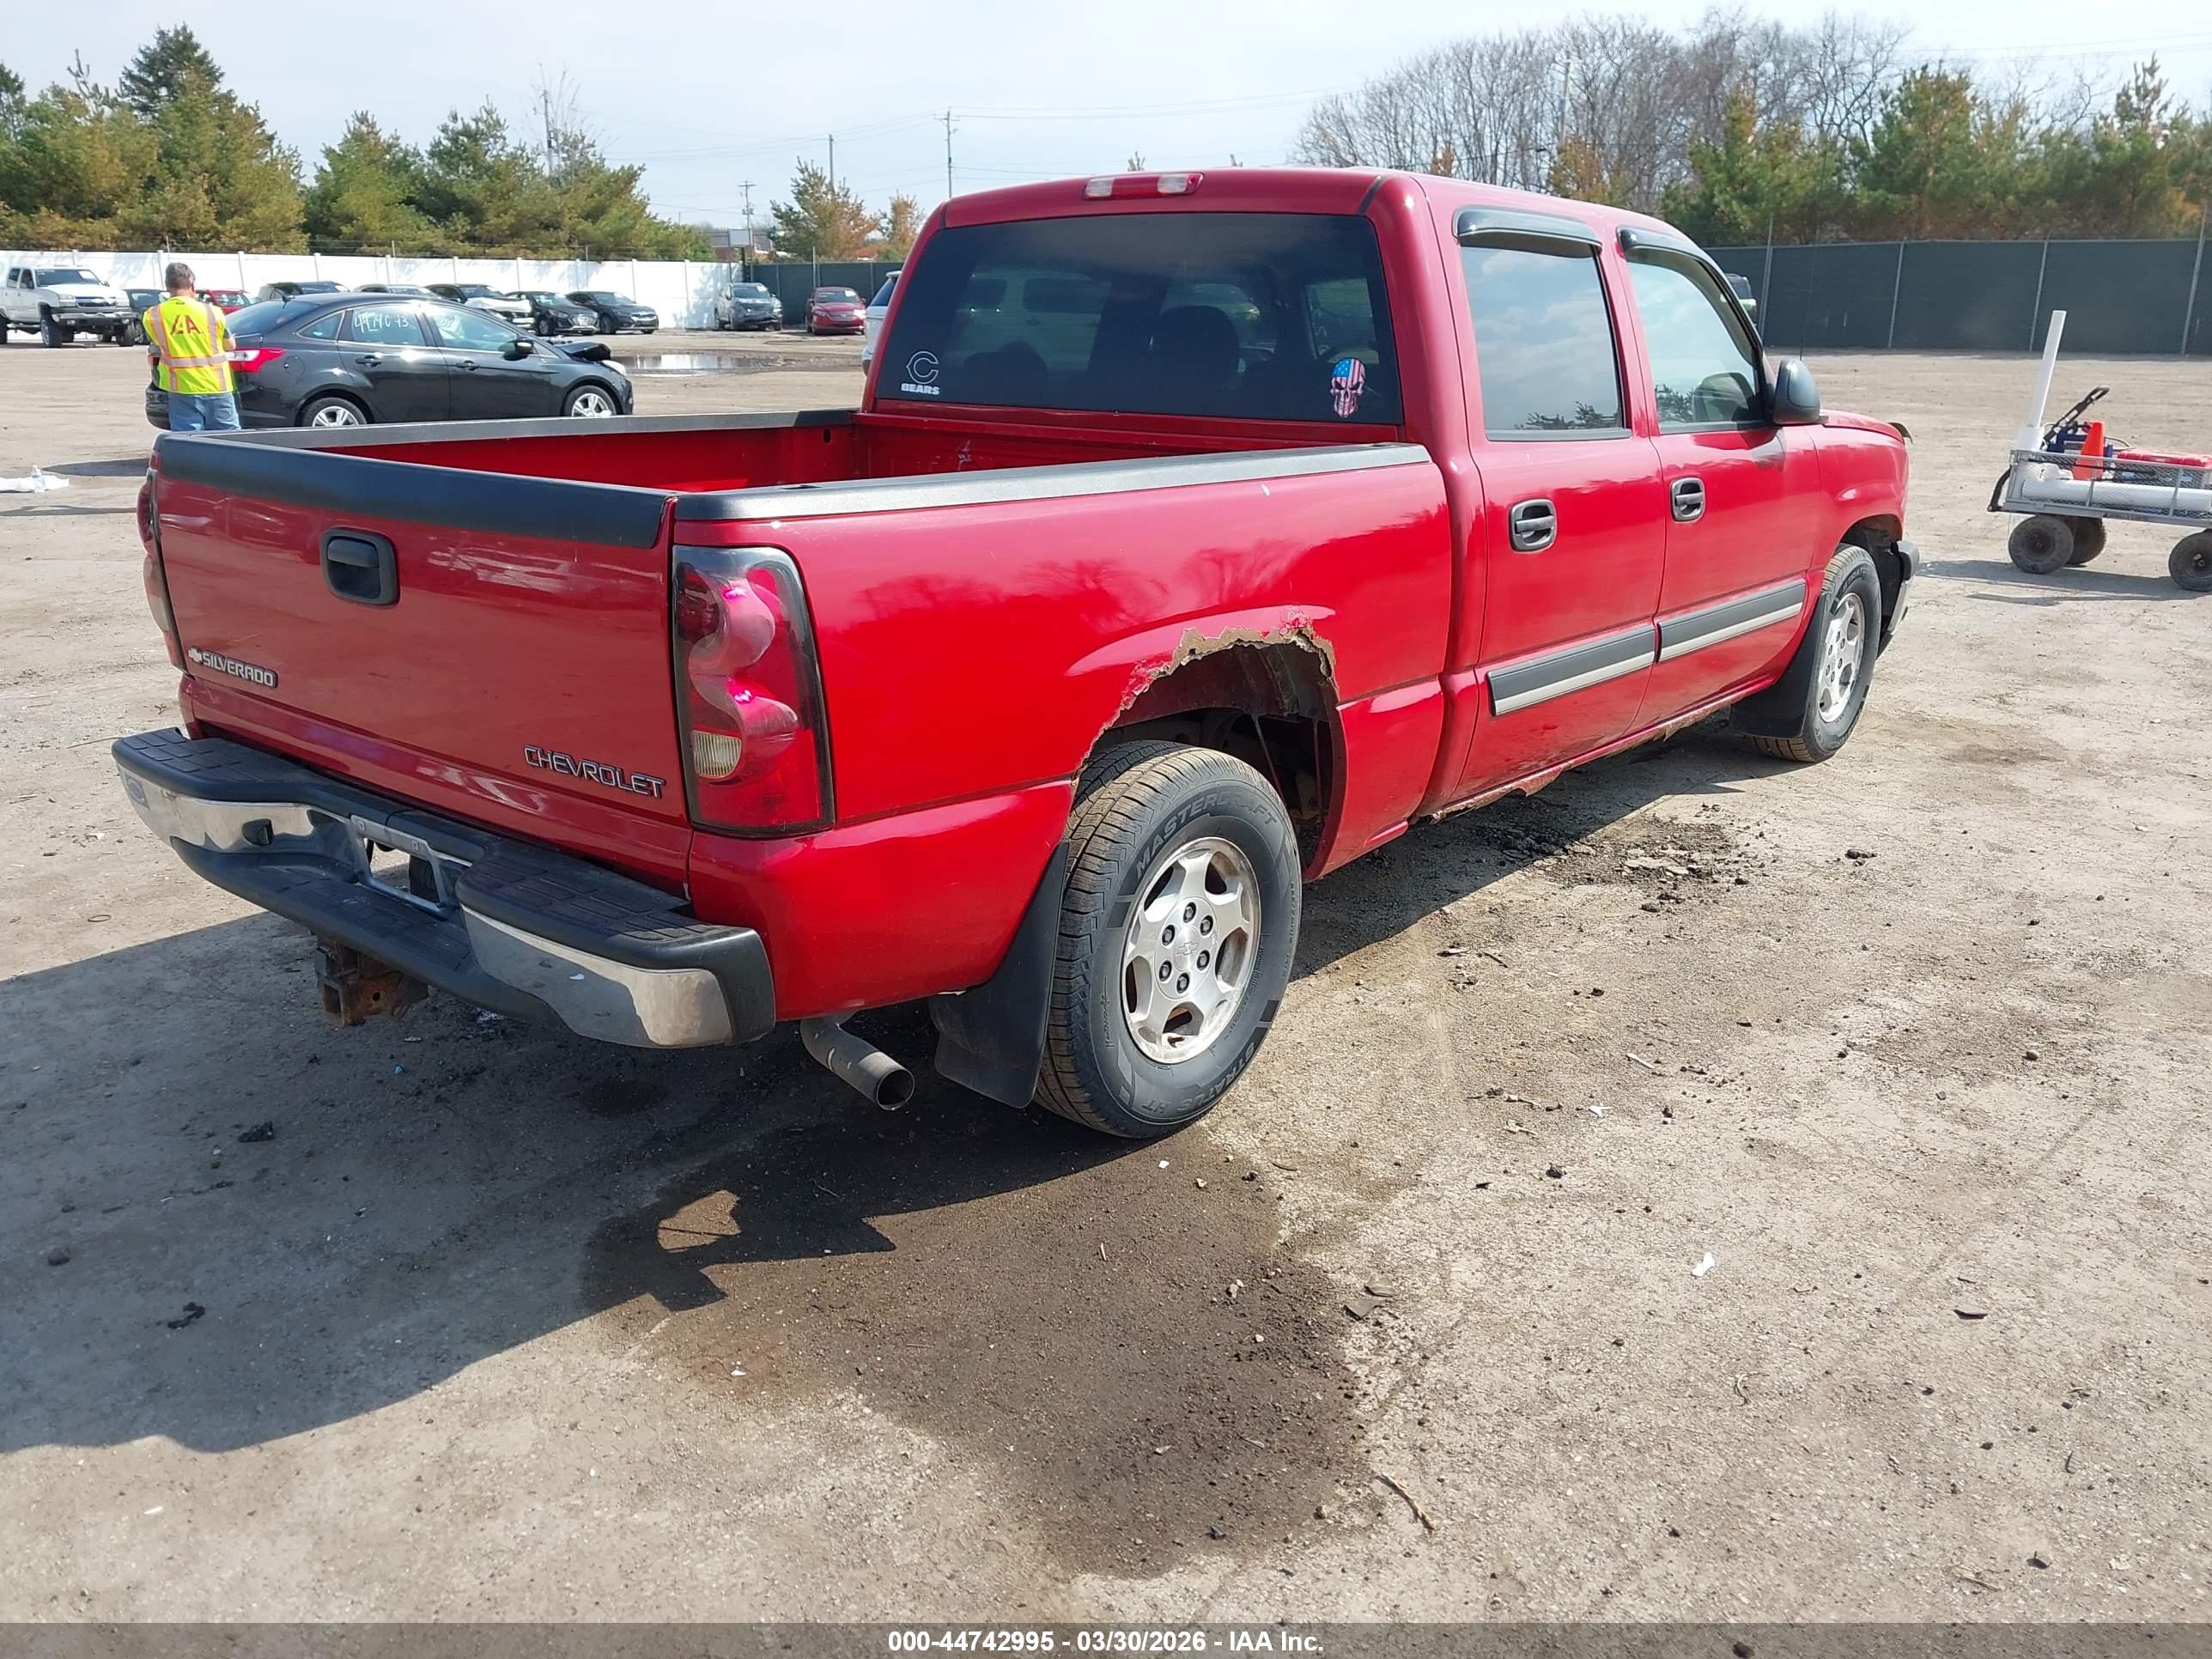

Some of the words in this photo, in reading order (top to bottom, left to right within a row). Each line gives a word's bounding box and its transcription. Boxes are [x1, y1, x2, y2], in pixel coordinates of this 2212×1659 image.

[901, 383, 940, 395] BEARS
[202, 653, 275, 688] SILVERADO
[524, 745, 666, 799] CHEVROLET
[1135, 790, 1278, 879] MASTERCFT
